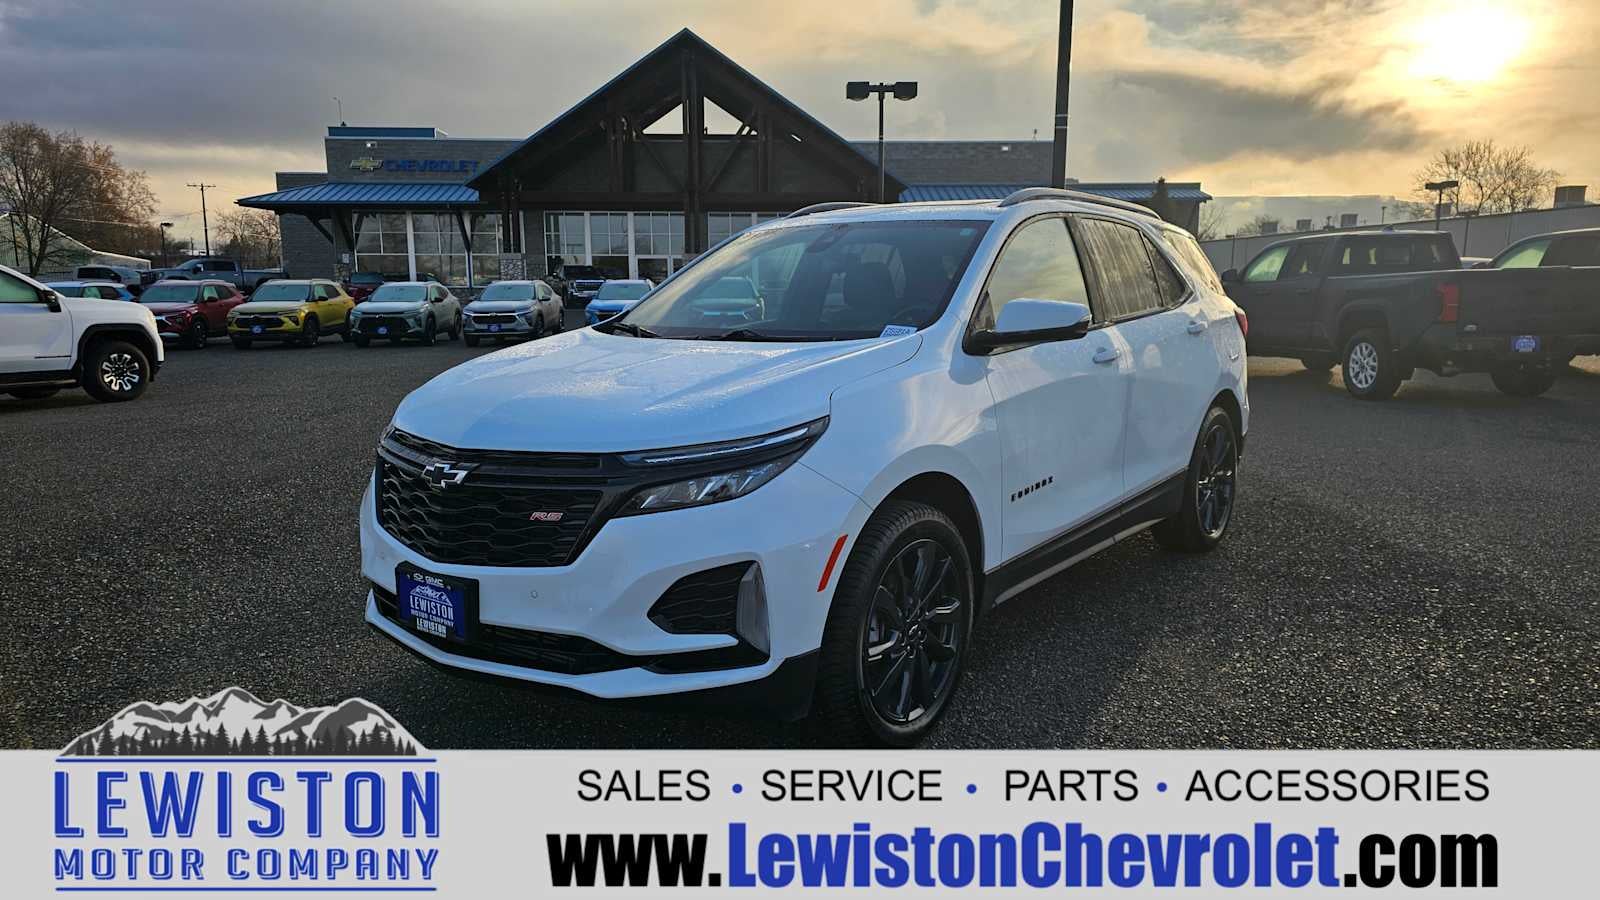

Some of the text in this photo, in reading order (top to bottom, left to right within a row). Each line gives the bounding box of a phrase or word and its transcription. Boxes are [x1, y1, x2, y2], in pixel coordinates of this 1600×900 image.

[385, 159, 479, 173] CHEVROLET
[530, 511, 563, 521] RS
[409, 595, 454, 620] LEWISTON
[416, 618, 447, 635] LEWISTON
